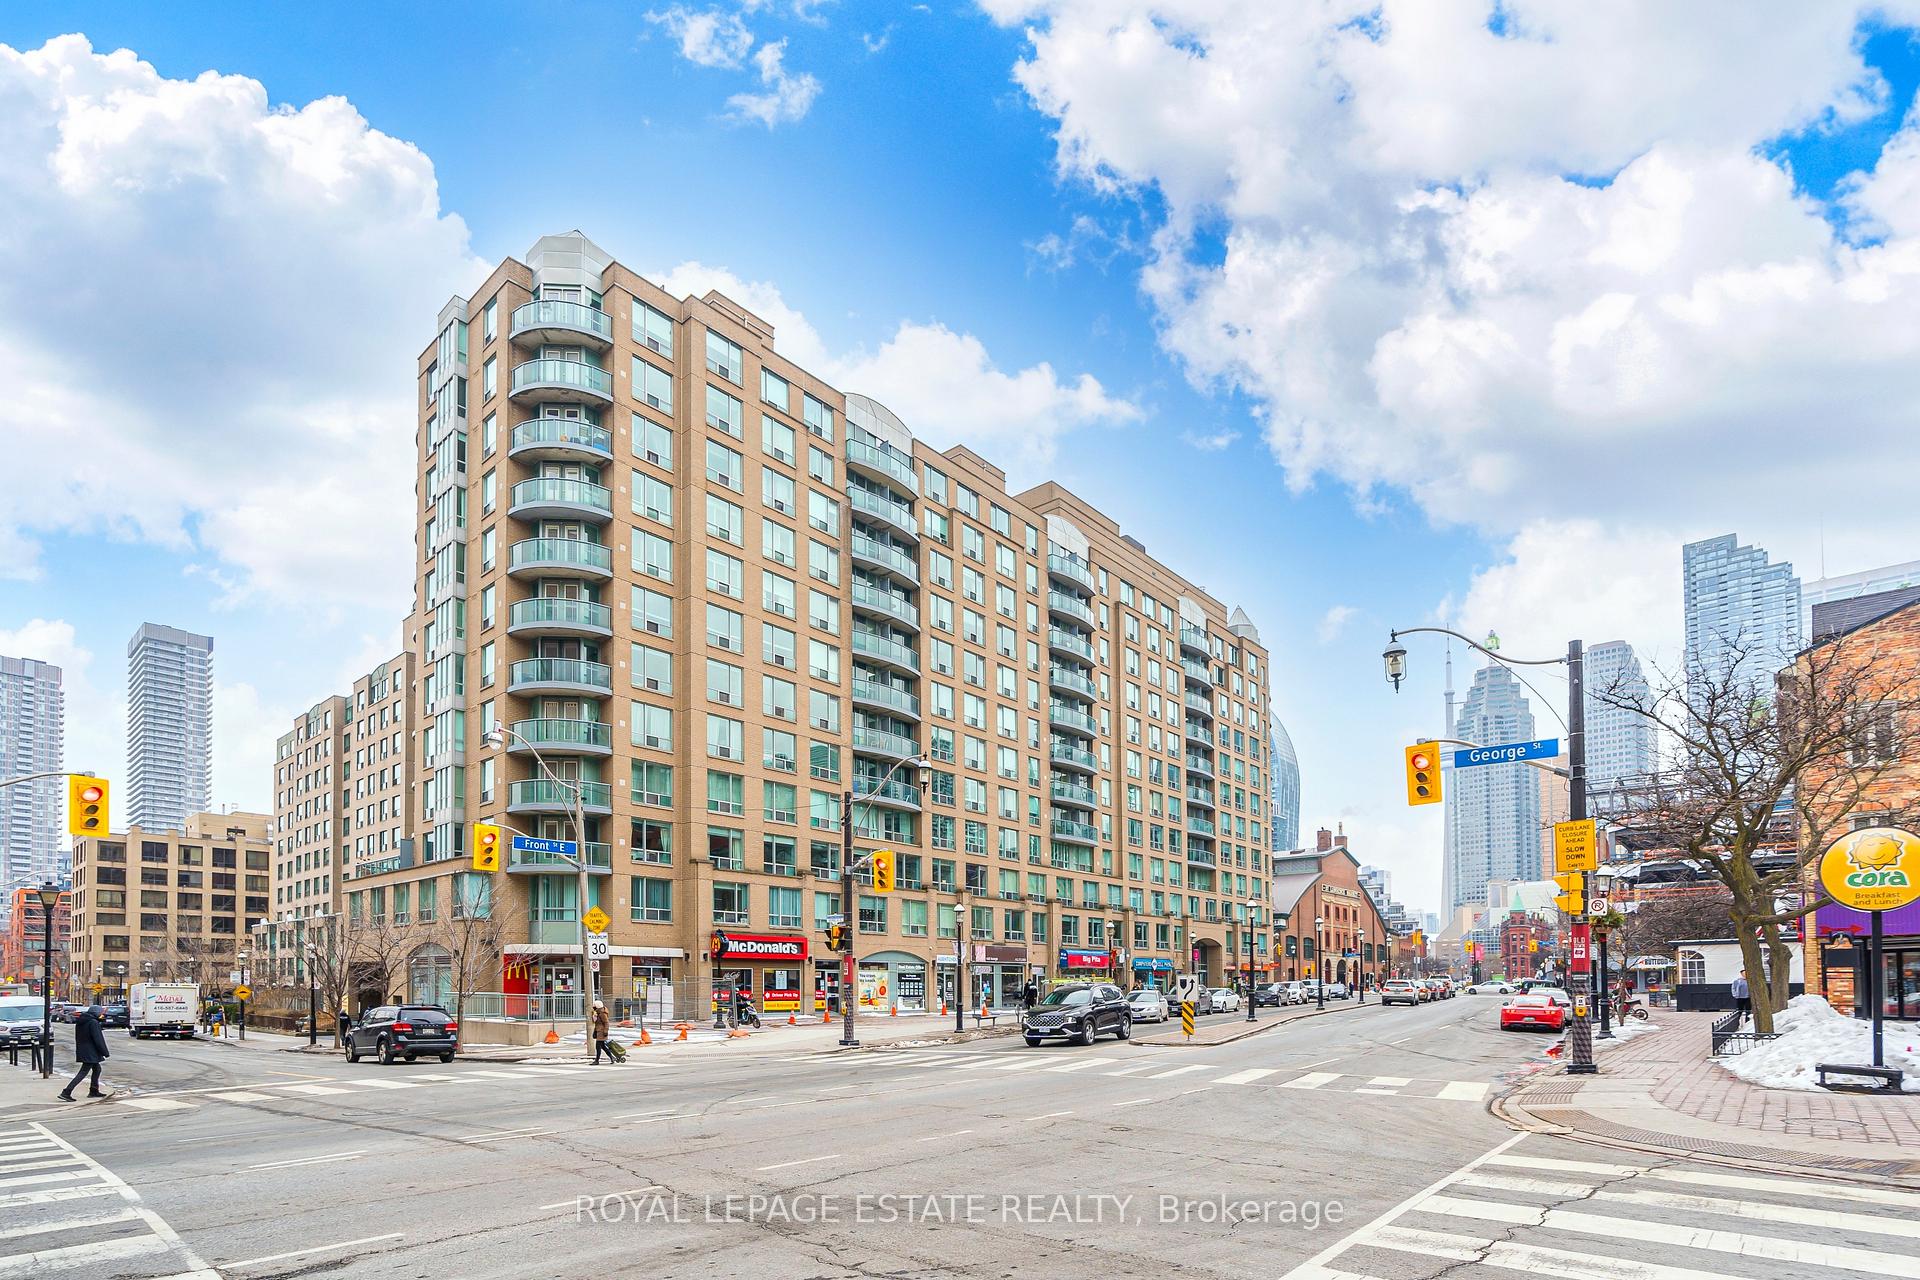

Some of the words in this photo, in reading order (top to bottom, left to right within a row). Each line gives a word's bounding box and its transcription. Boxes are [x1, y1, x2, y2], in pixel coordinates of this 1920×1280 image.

[1470, 746, 1526, 762] George
[525, 839, 549, 850] Front
[560, 843, 565, 851] E
[1847, 871, 1908, 887] cora
[591, 943, 607, 955] 30
[727, 941, 798, 954] McDonald's
